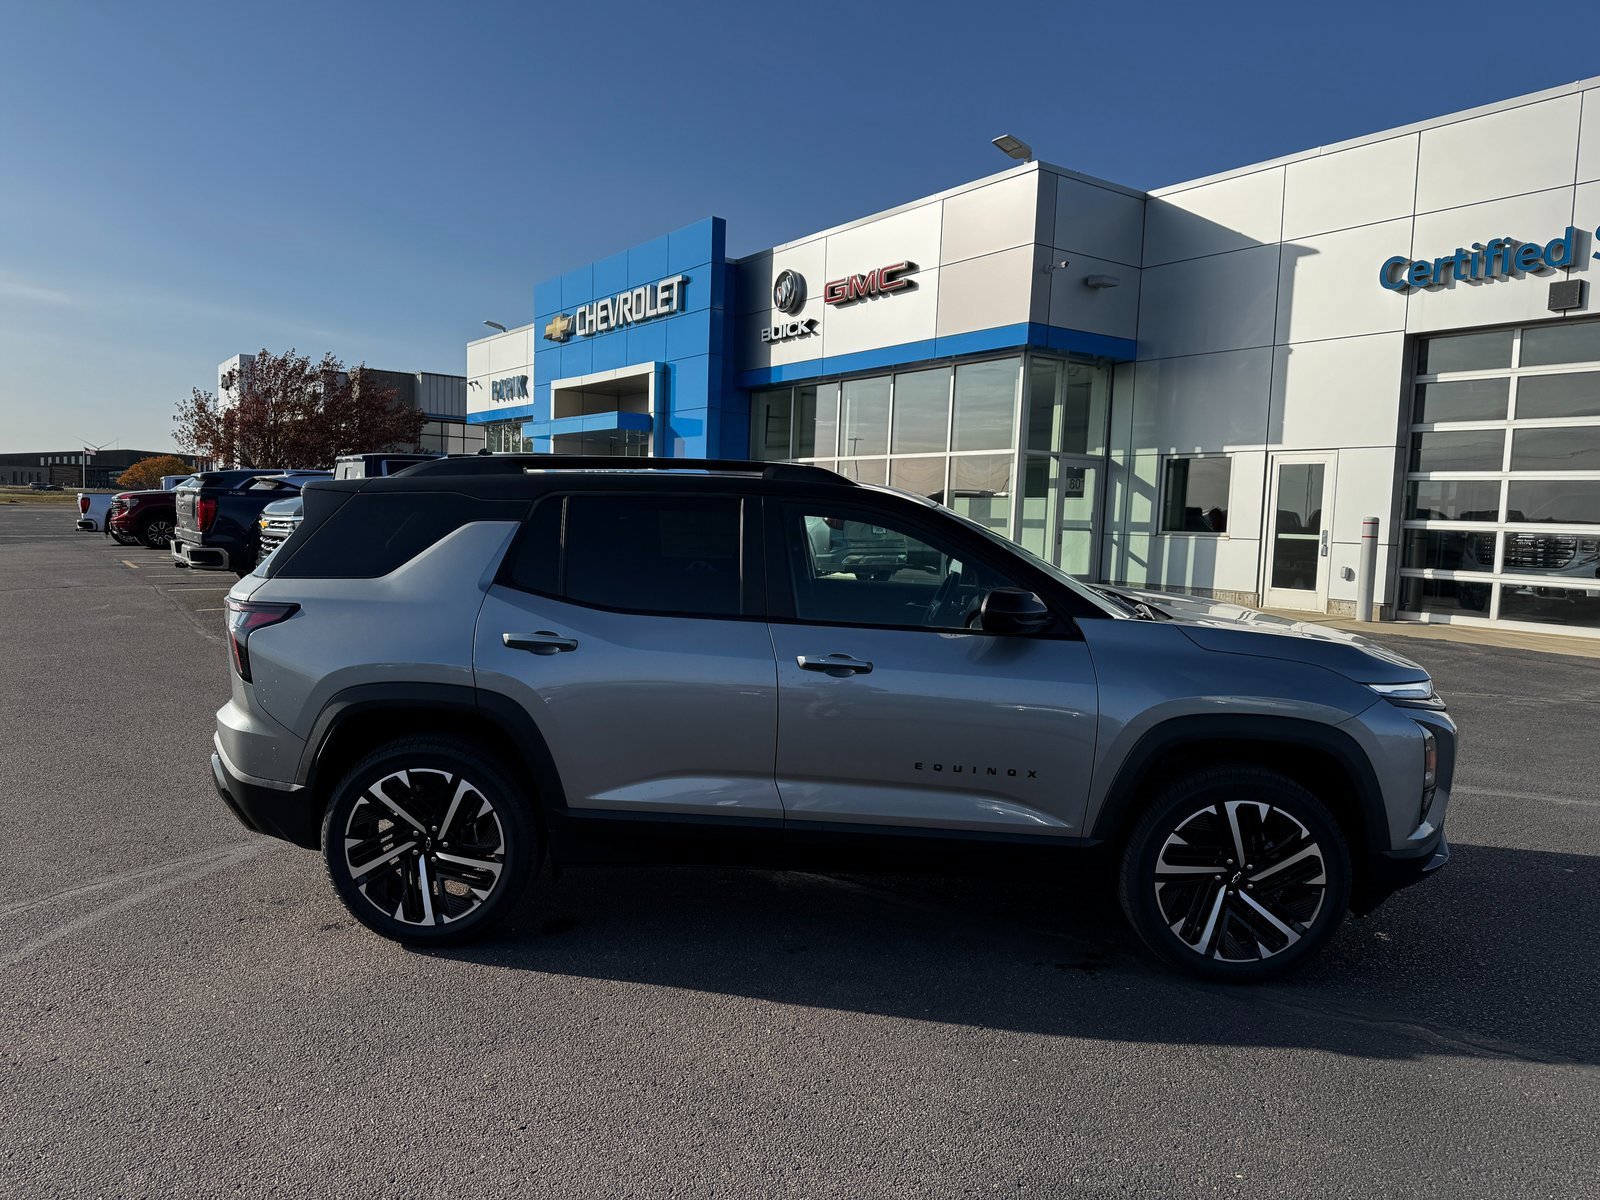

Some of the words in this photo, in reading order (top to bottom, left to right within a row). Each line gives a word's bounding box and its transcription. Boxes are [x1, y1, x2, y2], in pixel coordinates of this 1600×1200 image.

[1379, 226, 1574, 290] Certified
[824, 260, 908, 303] GMC
[576, 274, 685, 336] CHEVROLET
[761, 318, 813, 342] BUICK
[914, 762, 1037, 778] EQUINOX
